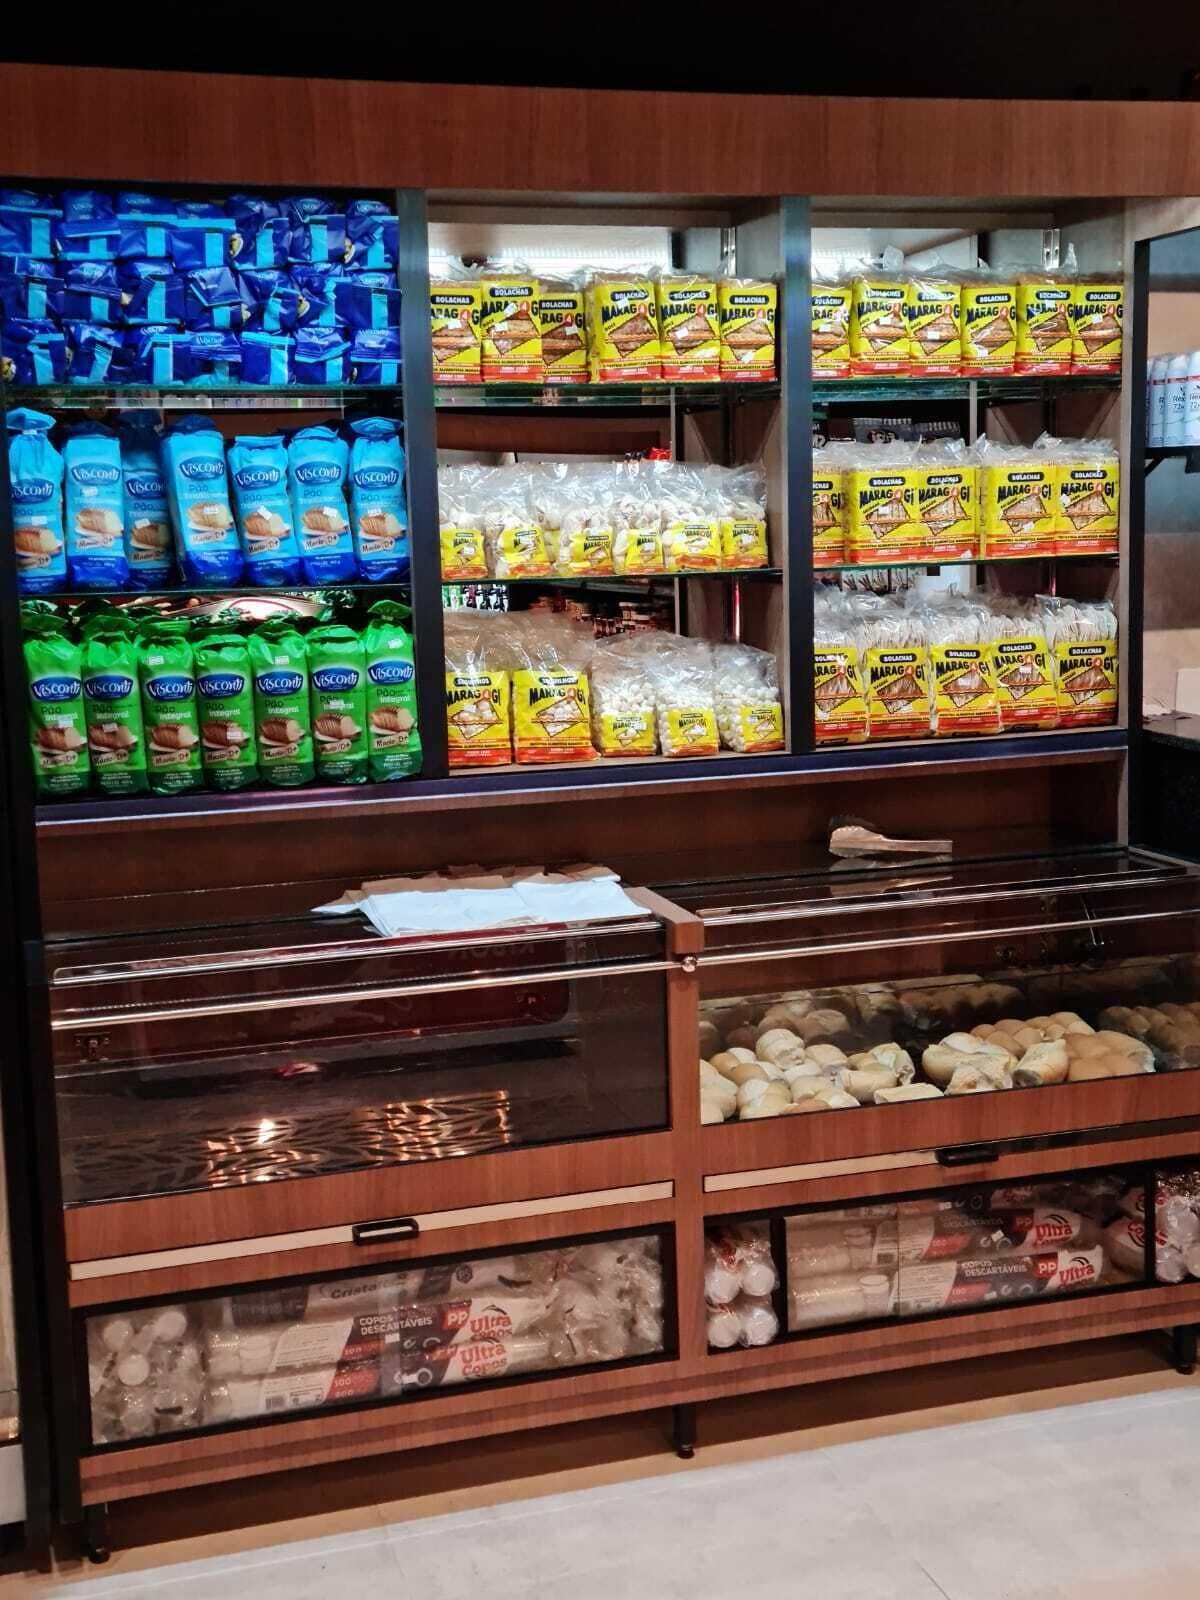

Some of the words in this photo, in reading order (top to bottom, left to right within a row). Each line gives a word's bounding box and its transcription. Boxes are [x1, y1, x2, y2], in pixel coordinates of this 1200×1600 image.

[313, 671, 359, 688] Visconti
[371, 665, 414, 679] Visconti
[33, 681, 81, 697] Visconti
[149, 681, 193, 697] Visconti
[258, 675, 303, 691] Visconti
[1038, 1262, 1057, 1275] PP
[1059, 1263, 1095, 1283] Ultra
[447, 1311, 469, 1327] PP
[470, 1314, 513, 1334] Ultra
[460, 1343, 506, 1364] Ultra
